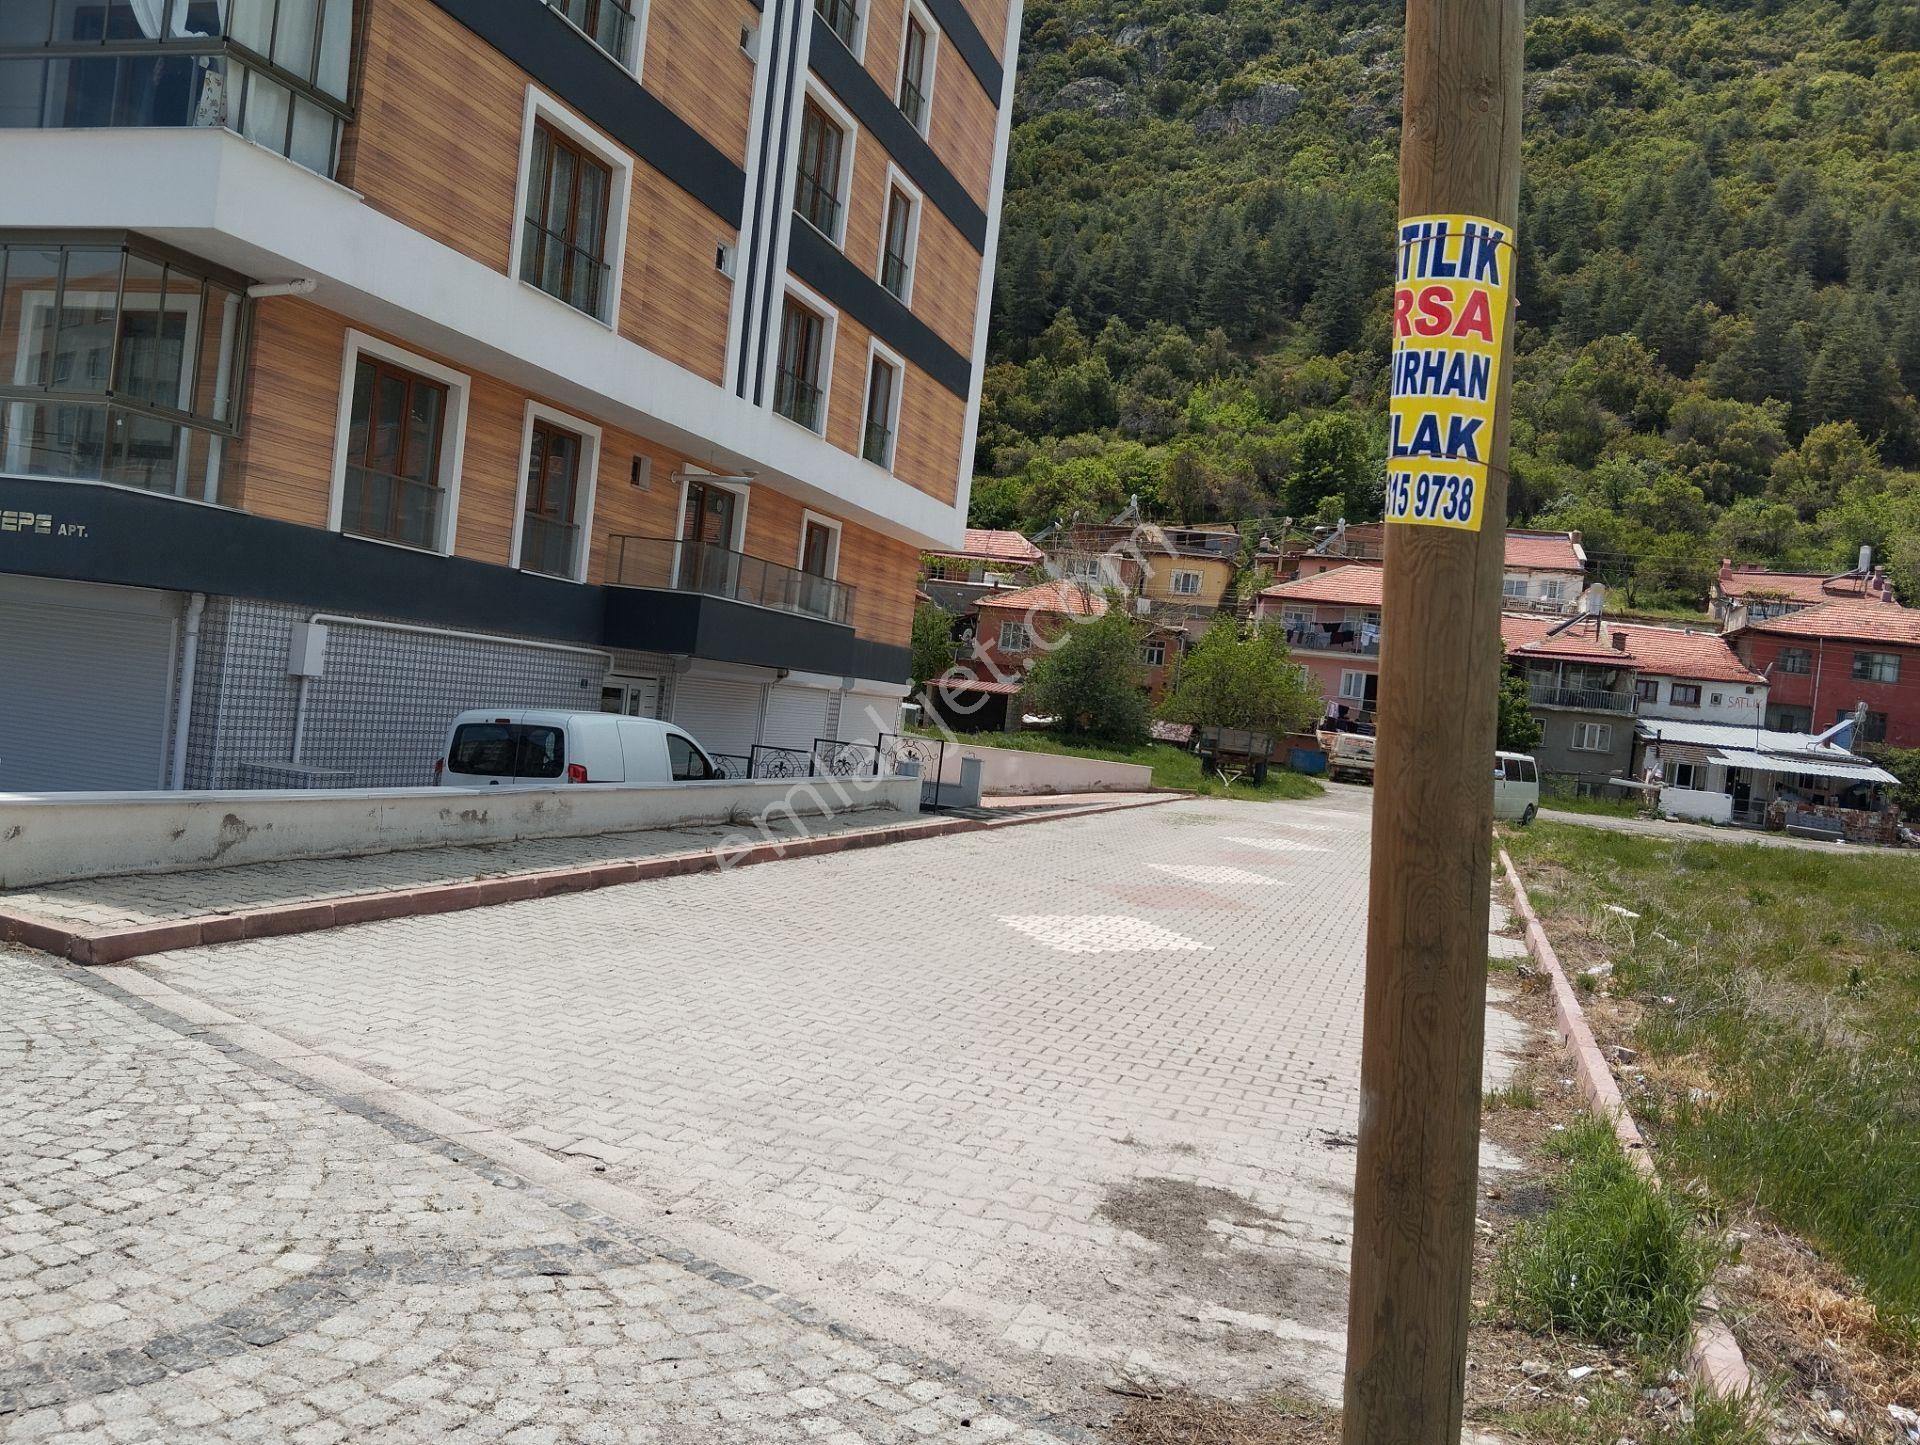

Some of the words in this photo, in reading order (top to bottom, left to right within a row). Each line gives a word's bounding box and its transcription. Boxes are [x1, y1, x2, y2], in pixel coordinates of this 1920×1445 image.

[1396, 222, 1504, 286] TILIK
[1394, 286, 1493, 342] RSA
[1393, 341, 1490, 401] İRHAN
[1390, 414, 1484, 463] LAK
[1414, 474, 1473, 521] 9738
[0, 510, 52, 534] EPE
[58, 523, 88, 538] APT.
